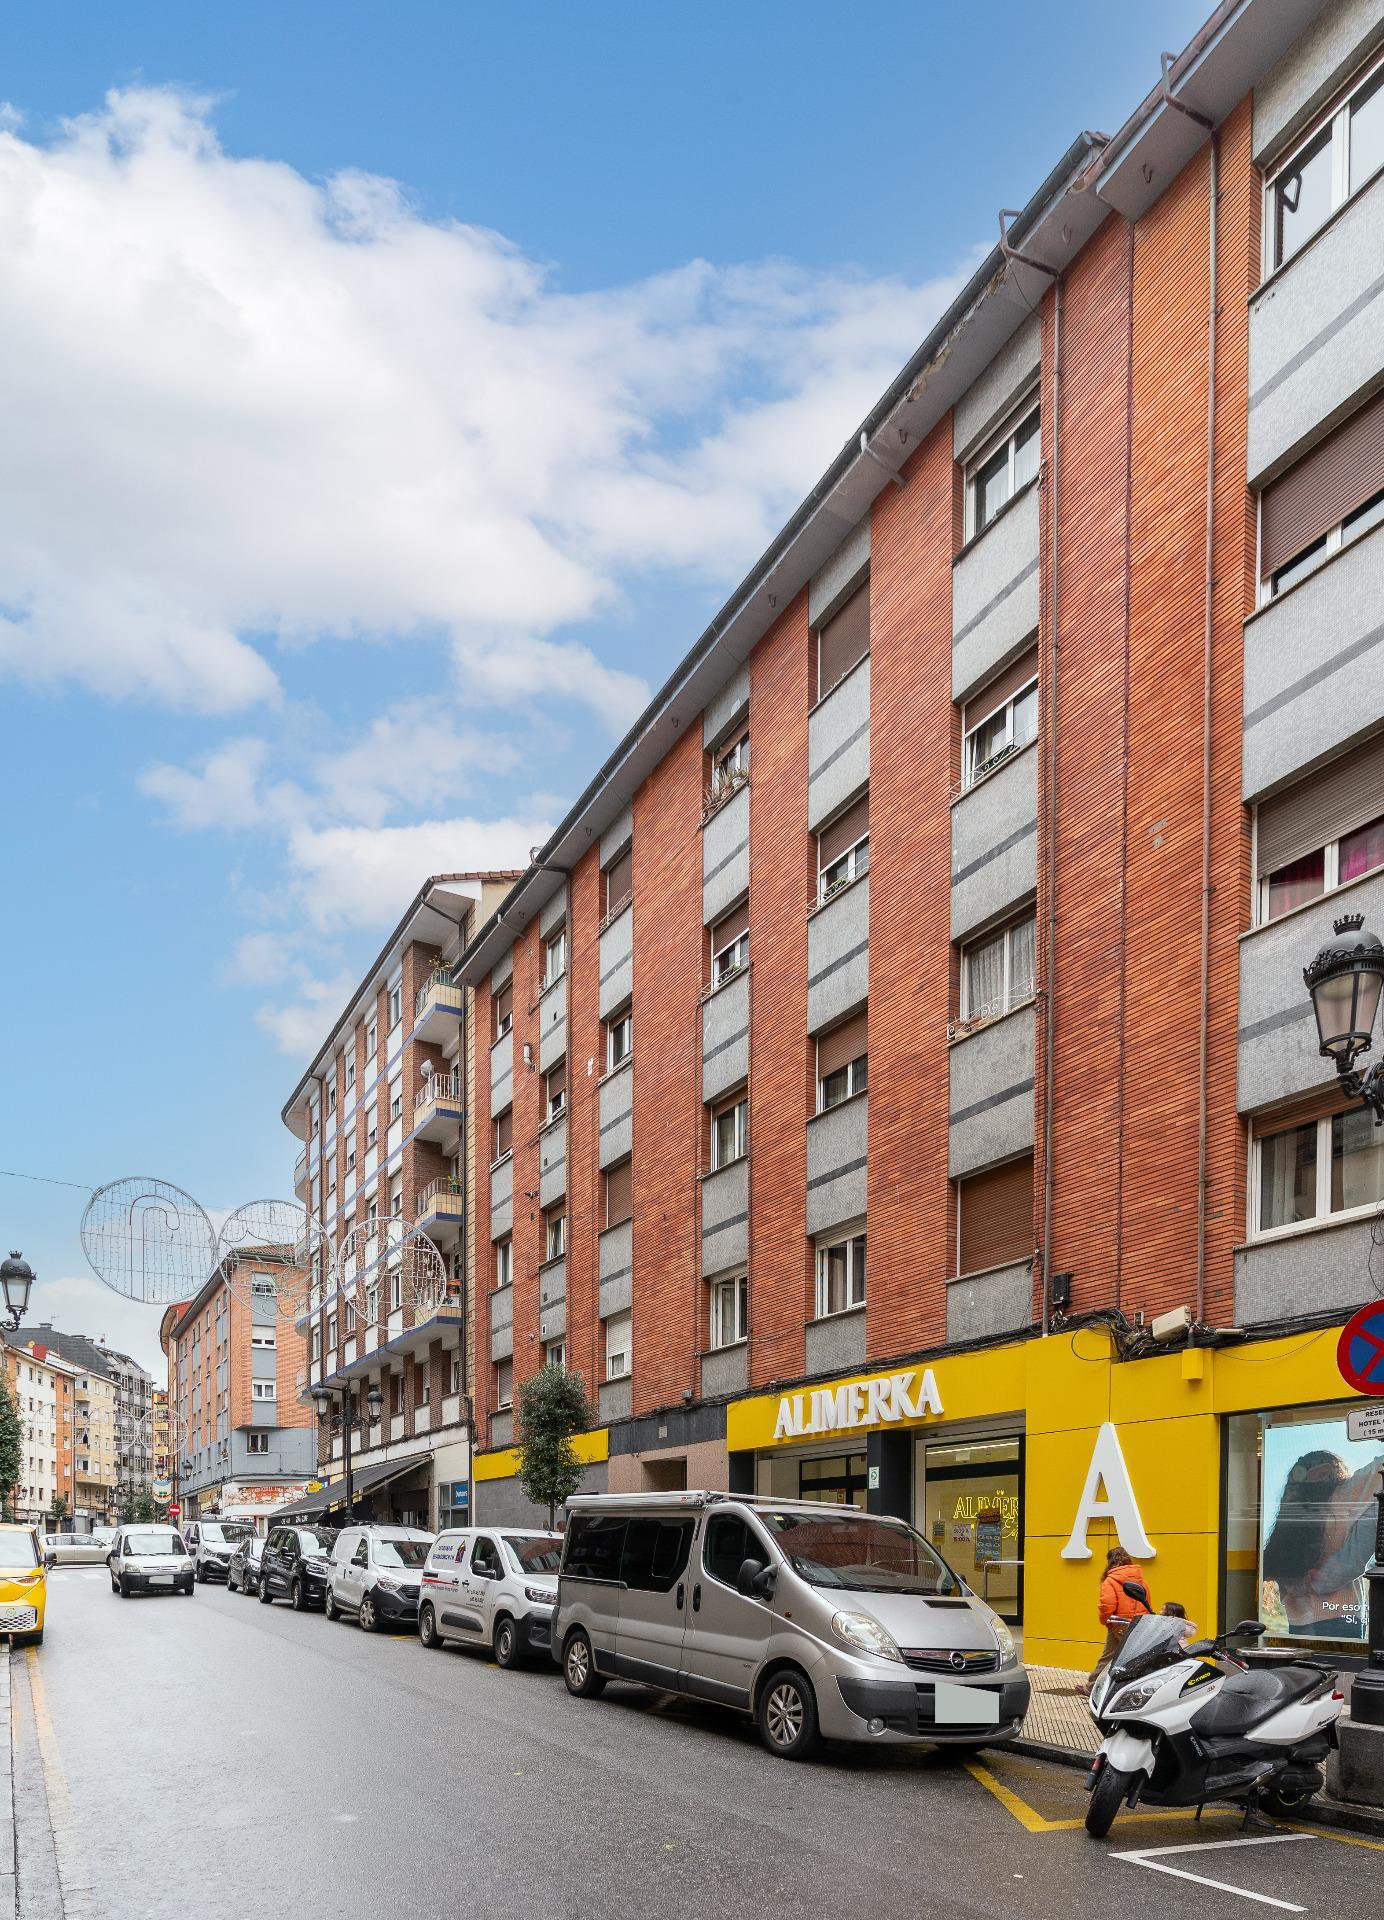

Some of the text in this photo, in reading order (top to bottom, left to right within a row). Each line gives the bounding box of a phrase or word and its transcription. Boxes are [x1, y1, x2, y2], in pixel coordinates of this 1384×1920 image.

[773, 1369, 944, 1438] ALIMERKA
[1358, 1419, 1381, 1427] HOTEL
[1061, 1421, 1156, 1558] A
[1322, 1601, 1339, 1611] Por
[1195, 1672, 1211, 1682] KYMCO
